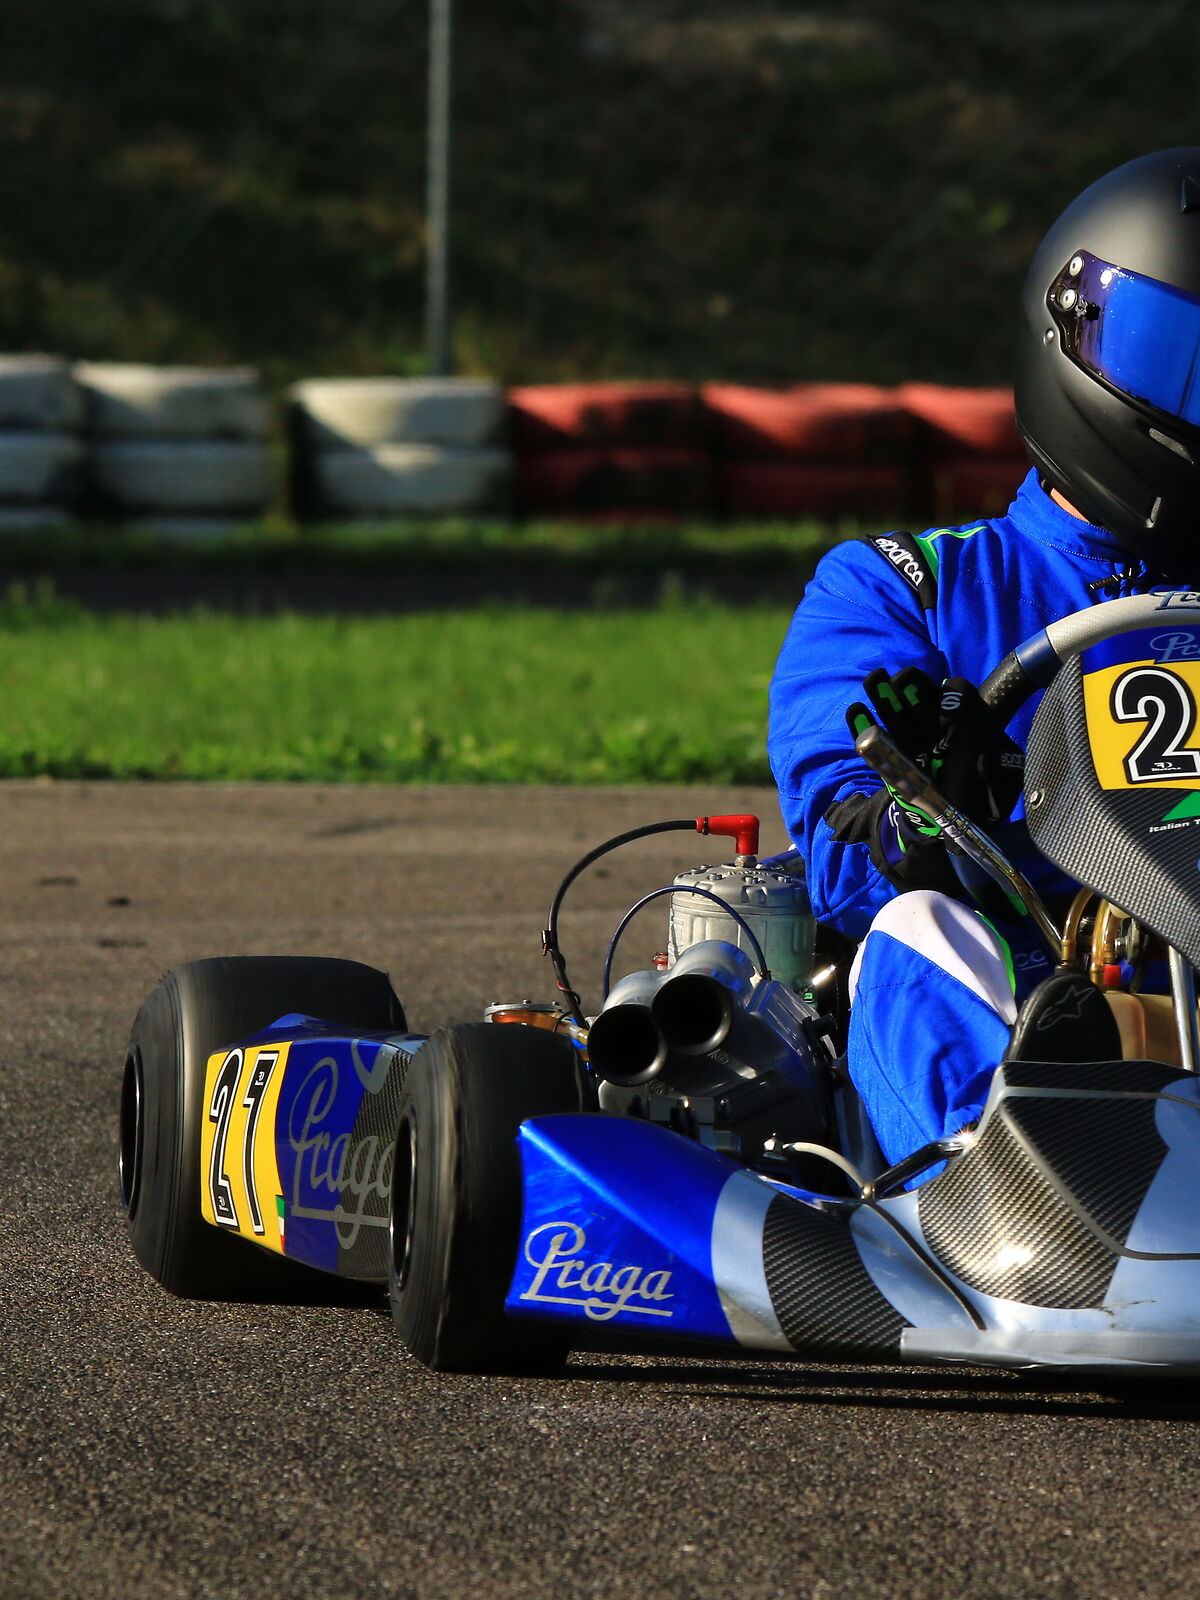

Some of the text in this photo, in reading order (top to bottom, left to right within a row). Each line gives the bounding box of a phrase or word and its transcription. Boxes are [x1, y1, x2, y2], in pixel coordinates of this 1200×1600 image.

[874, 538, 924, 587] sparco
[1149, 820, 1189, 833] Italian
[519, 1221, 674, 1321] Praga
